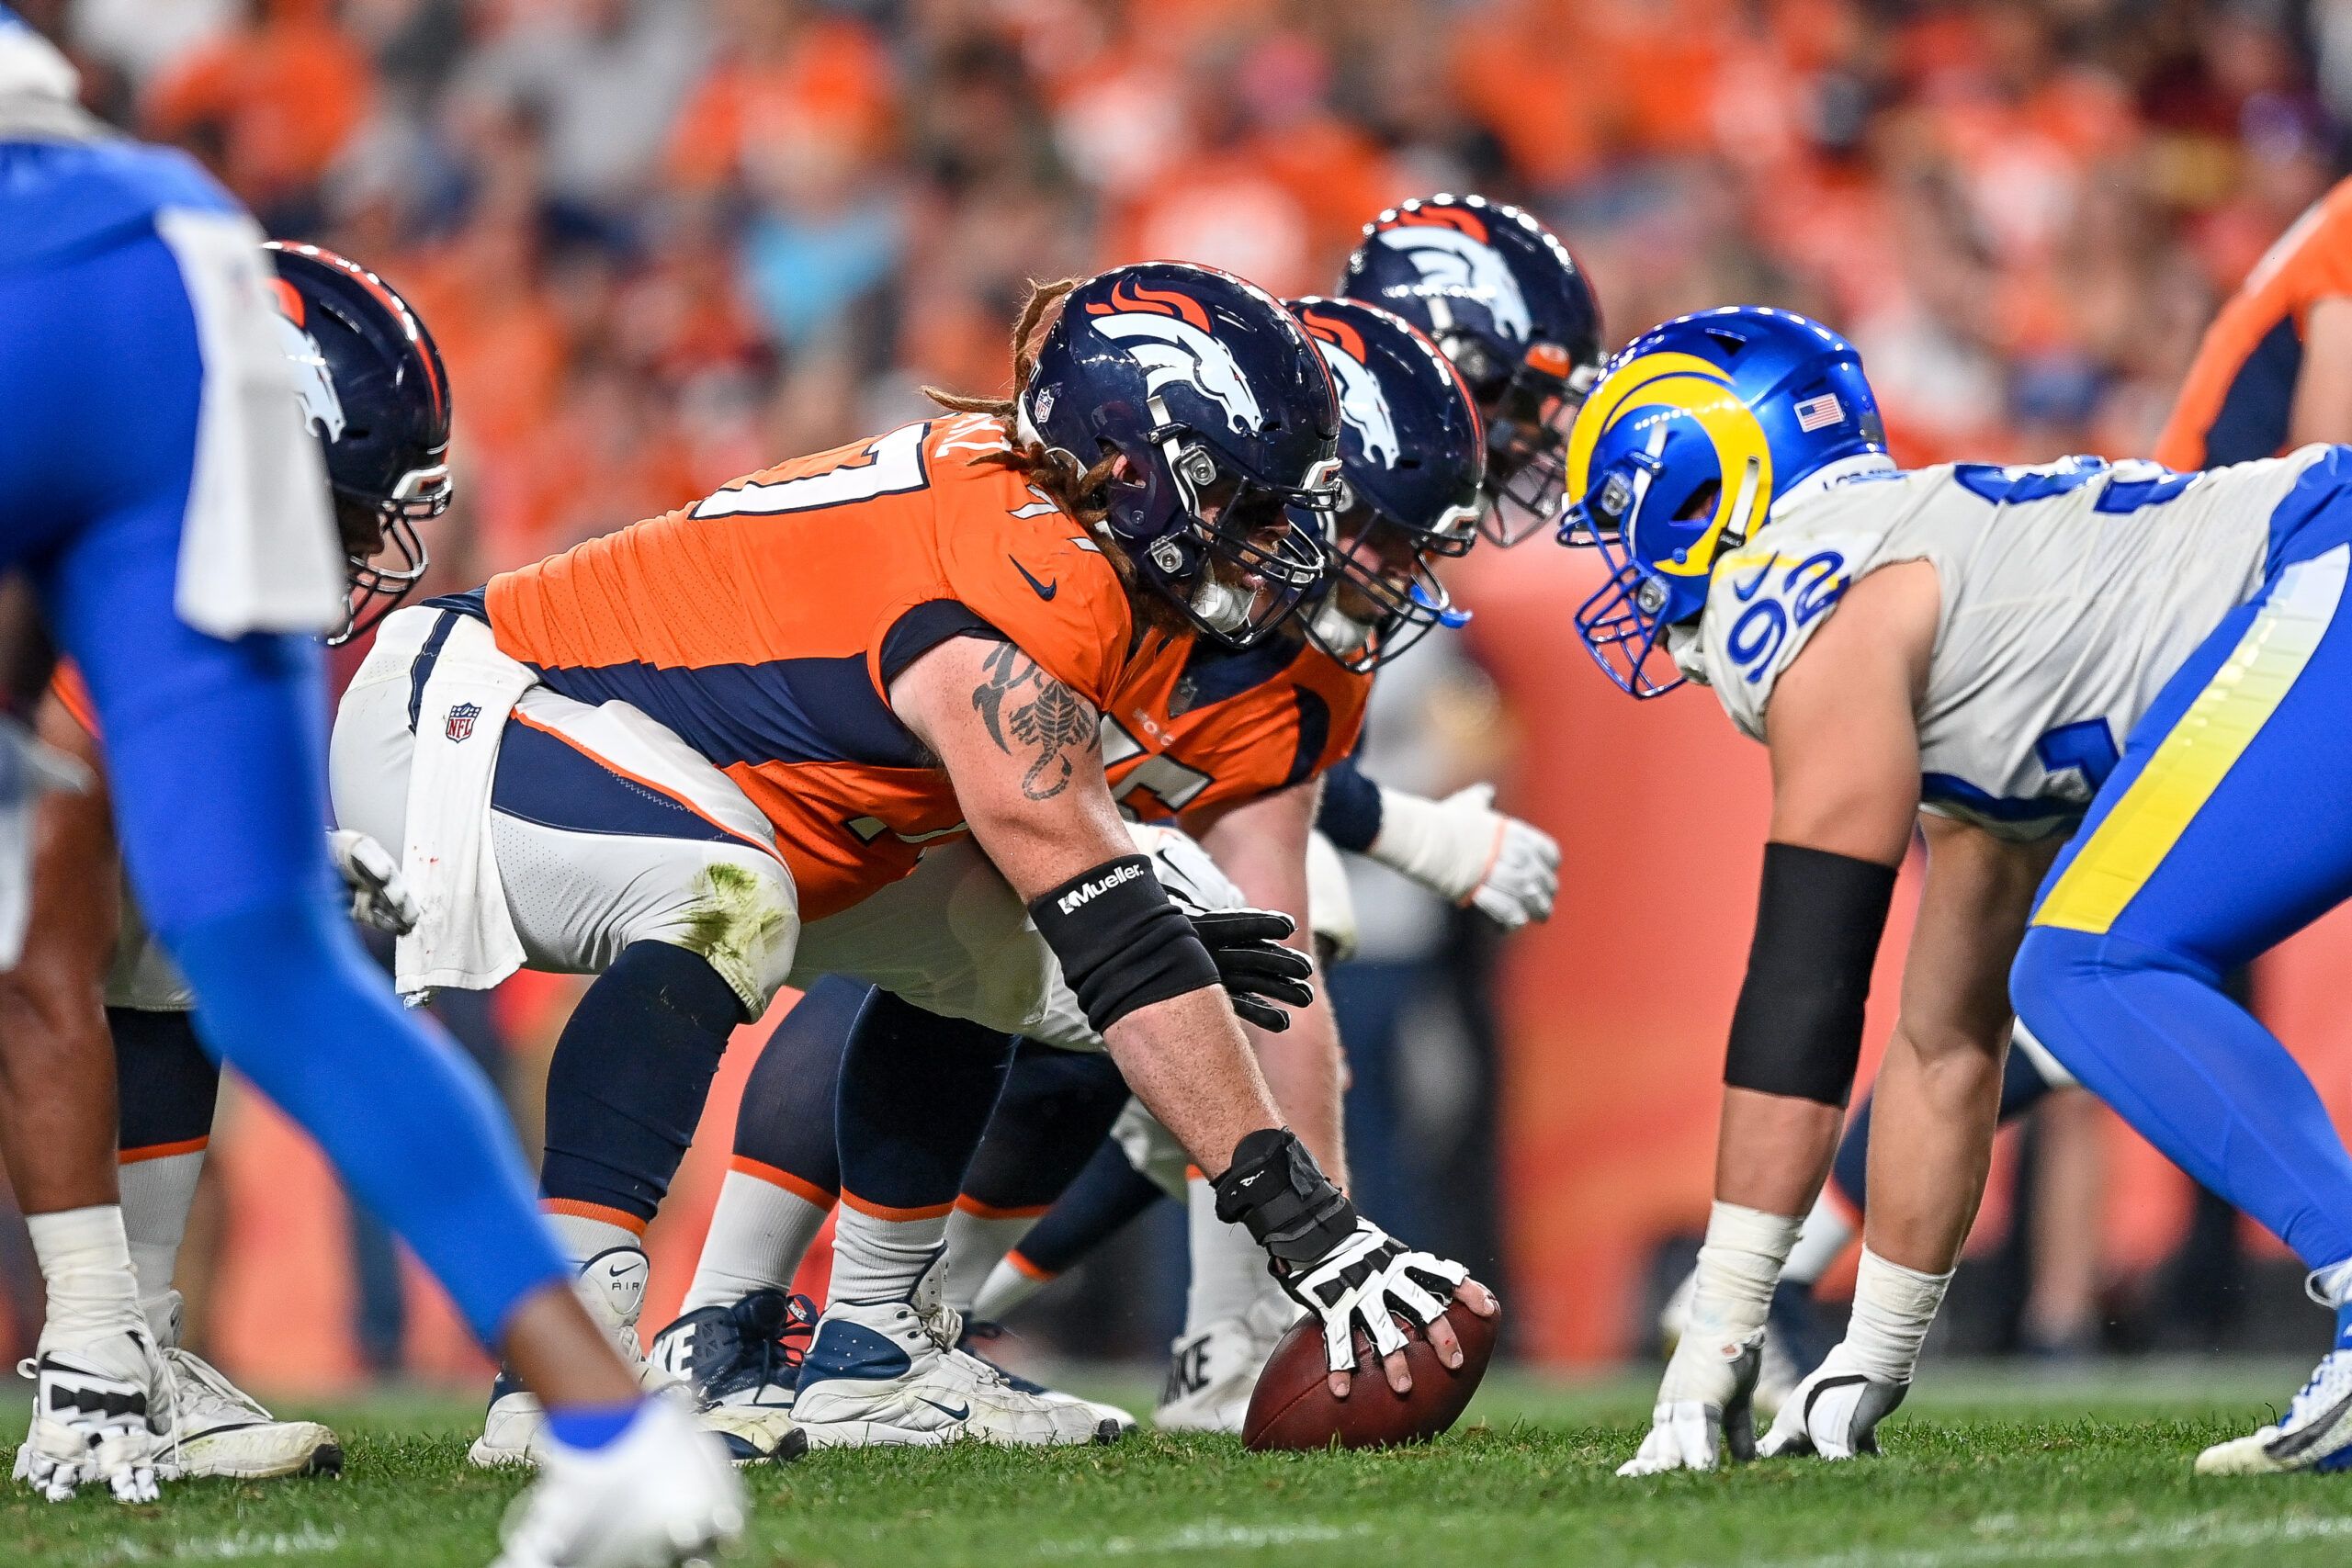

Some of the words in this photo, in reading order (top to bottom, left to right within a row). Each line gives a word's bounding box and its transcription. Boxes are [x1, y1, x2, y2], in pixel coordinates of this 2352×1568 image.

[1727, 551, 1850, 683] 92
[447, 717, 472, 739] NFL
[612, 1281, 640, 1291] AIR
